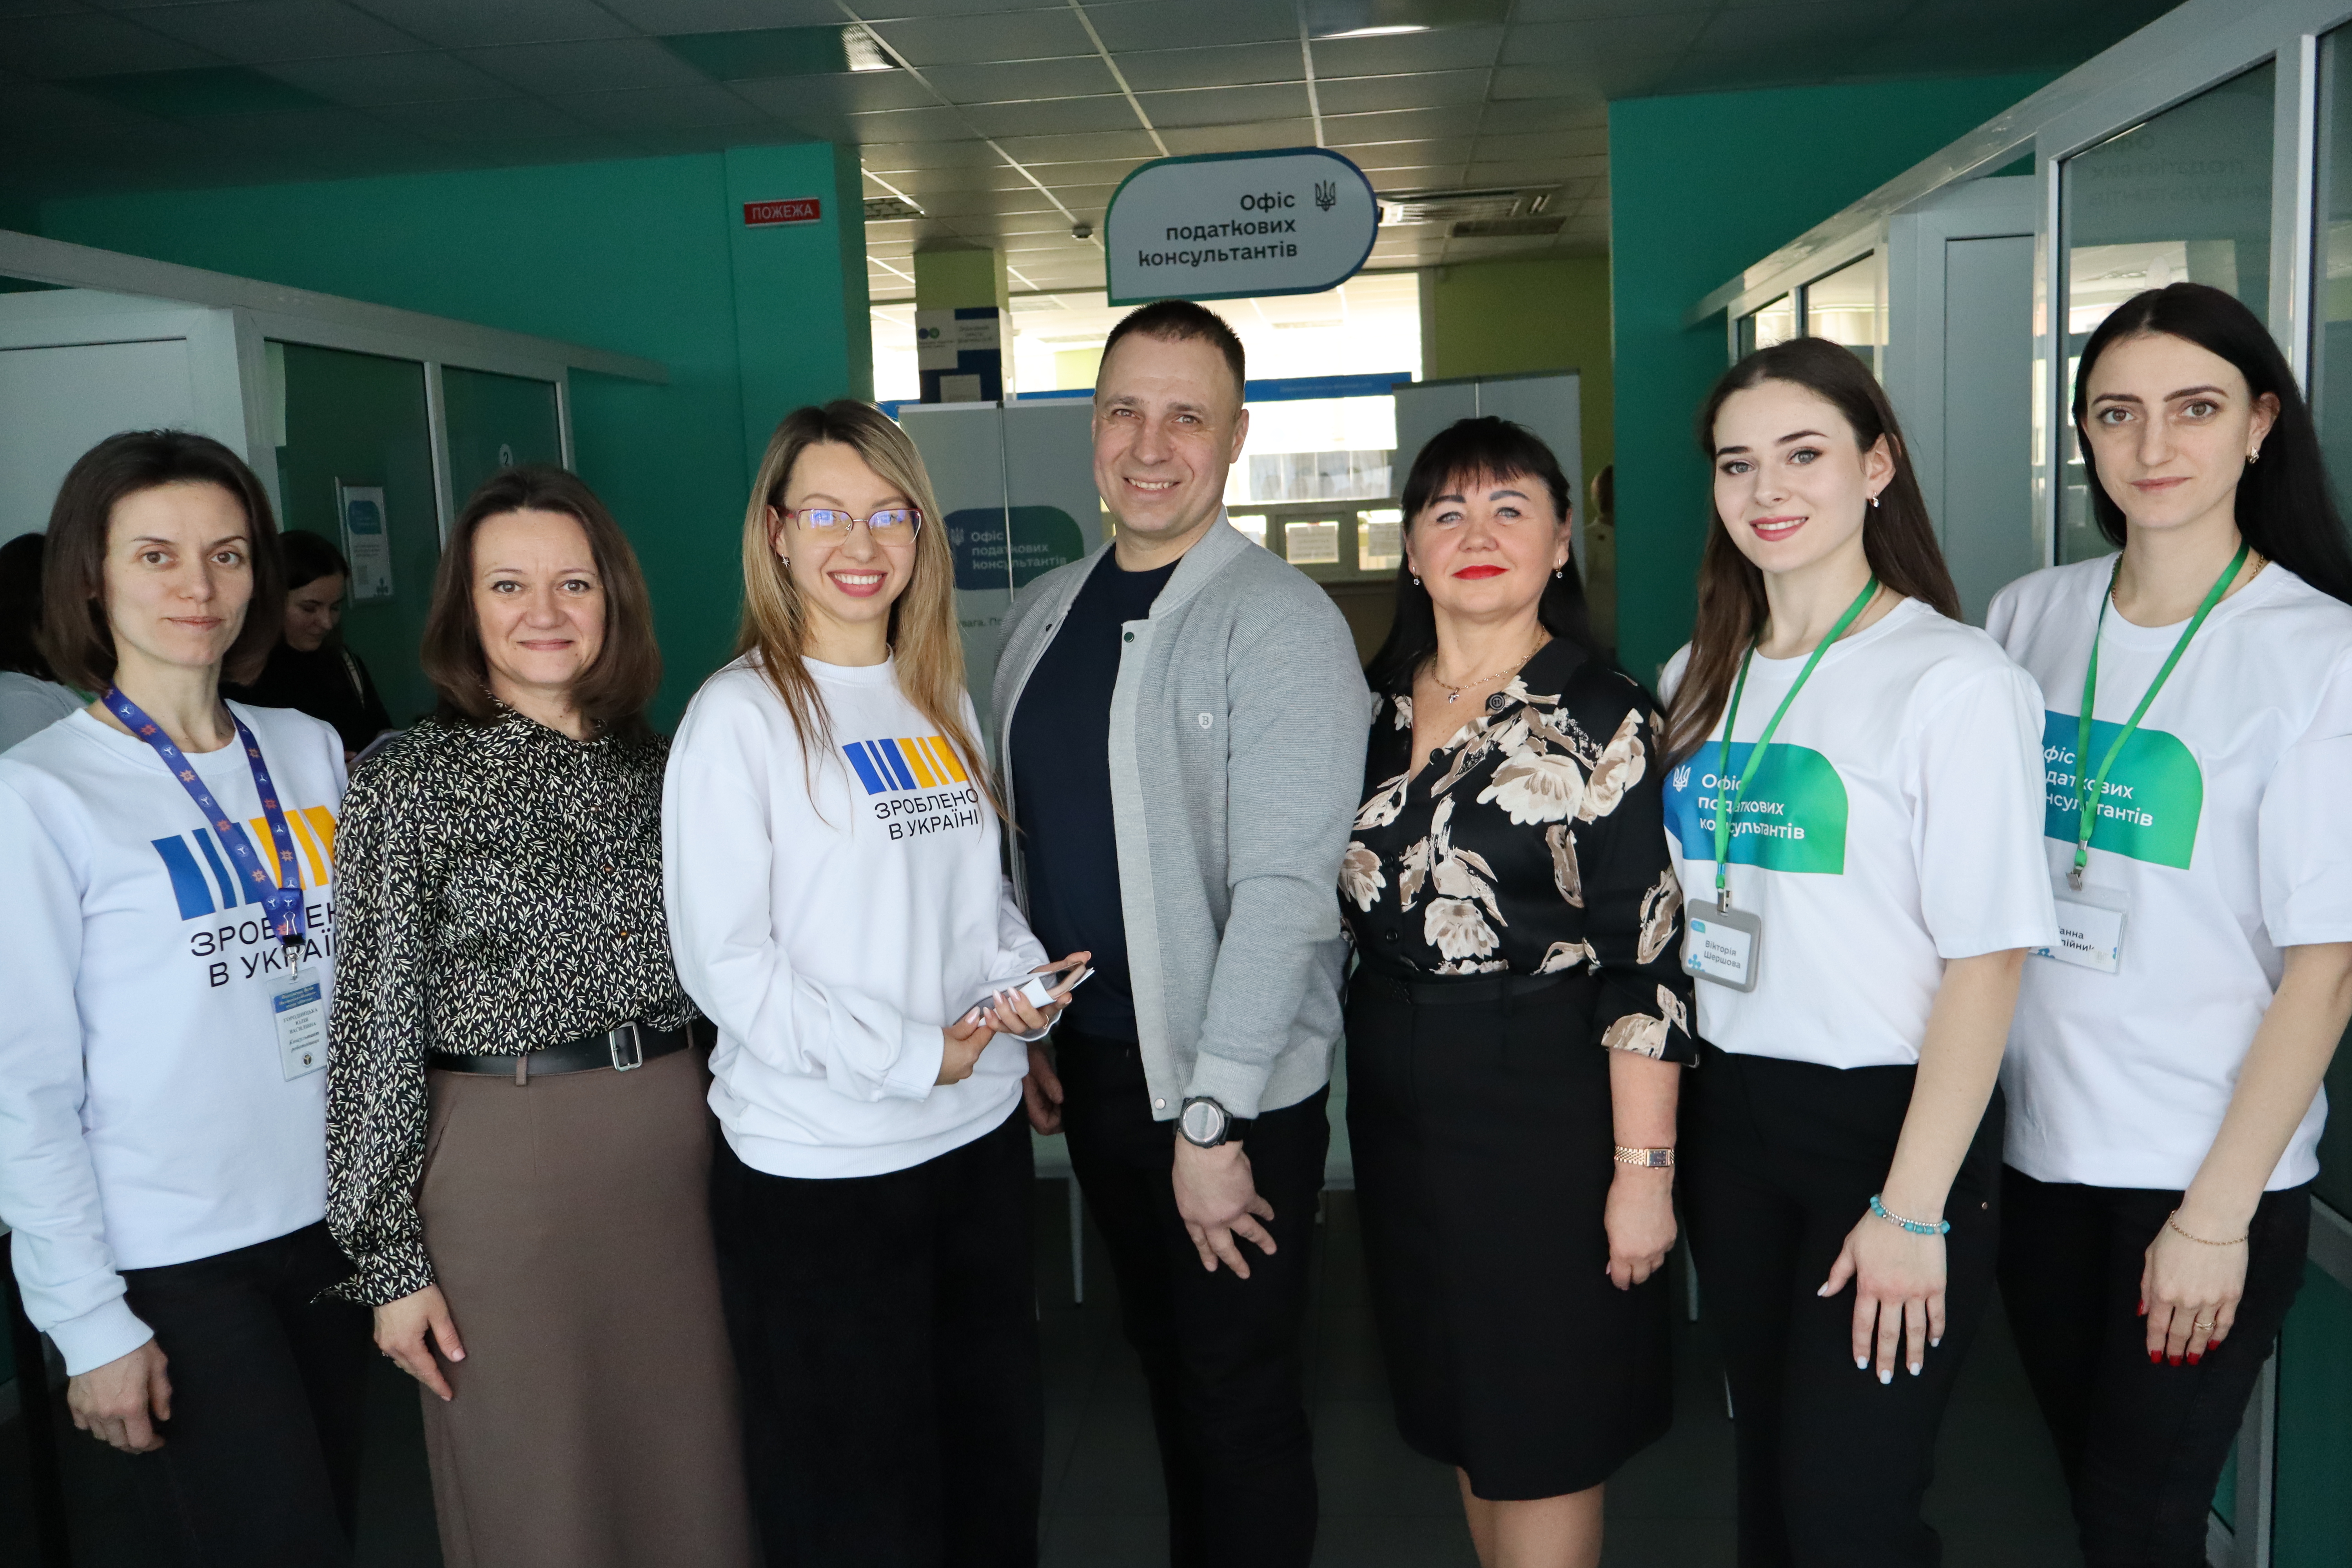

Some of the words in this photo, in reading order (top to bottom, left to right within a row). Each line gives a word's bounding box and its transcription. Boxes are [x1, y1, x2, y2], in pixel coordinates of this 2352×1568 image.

[752, 203, 813, 220] ПОЖЕЖА
[1240, 192, 1295, 213] Офіс
[1167, 219, 1296, 240] податкових
[1139, 241, 1297, 267] консультантів
[971, 531, 1004, 543] Офіс
[2043, 745, 2075, 764] фіс
[875, 788, 979, 819] ЗРОБЛЕНО
[889, 823, 903, 840] В
[907, 809, 978, 837] УКРАЇНІ
[1700, 818, 1805, 839] косультантів
[2059, 926, 2084, 939] анна
[1705, 940, 1737, 956] Вікторія
[1704, 951, 1741, 969] Шершова
[209, 962, 229, 987] В
